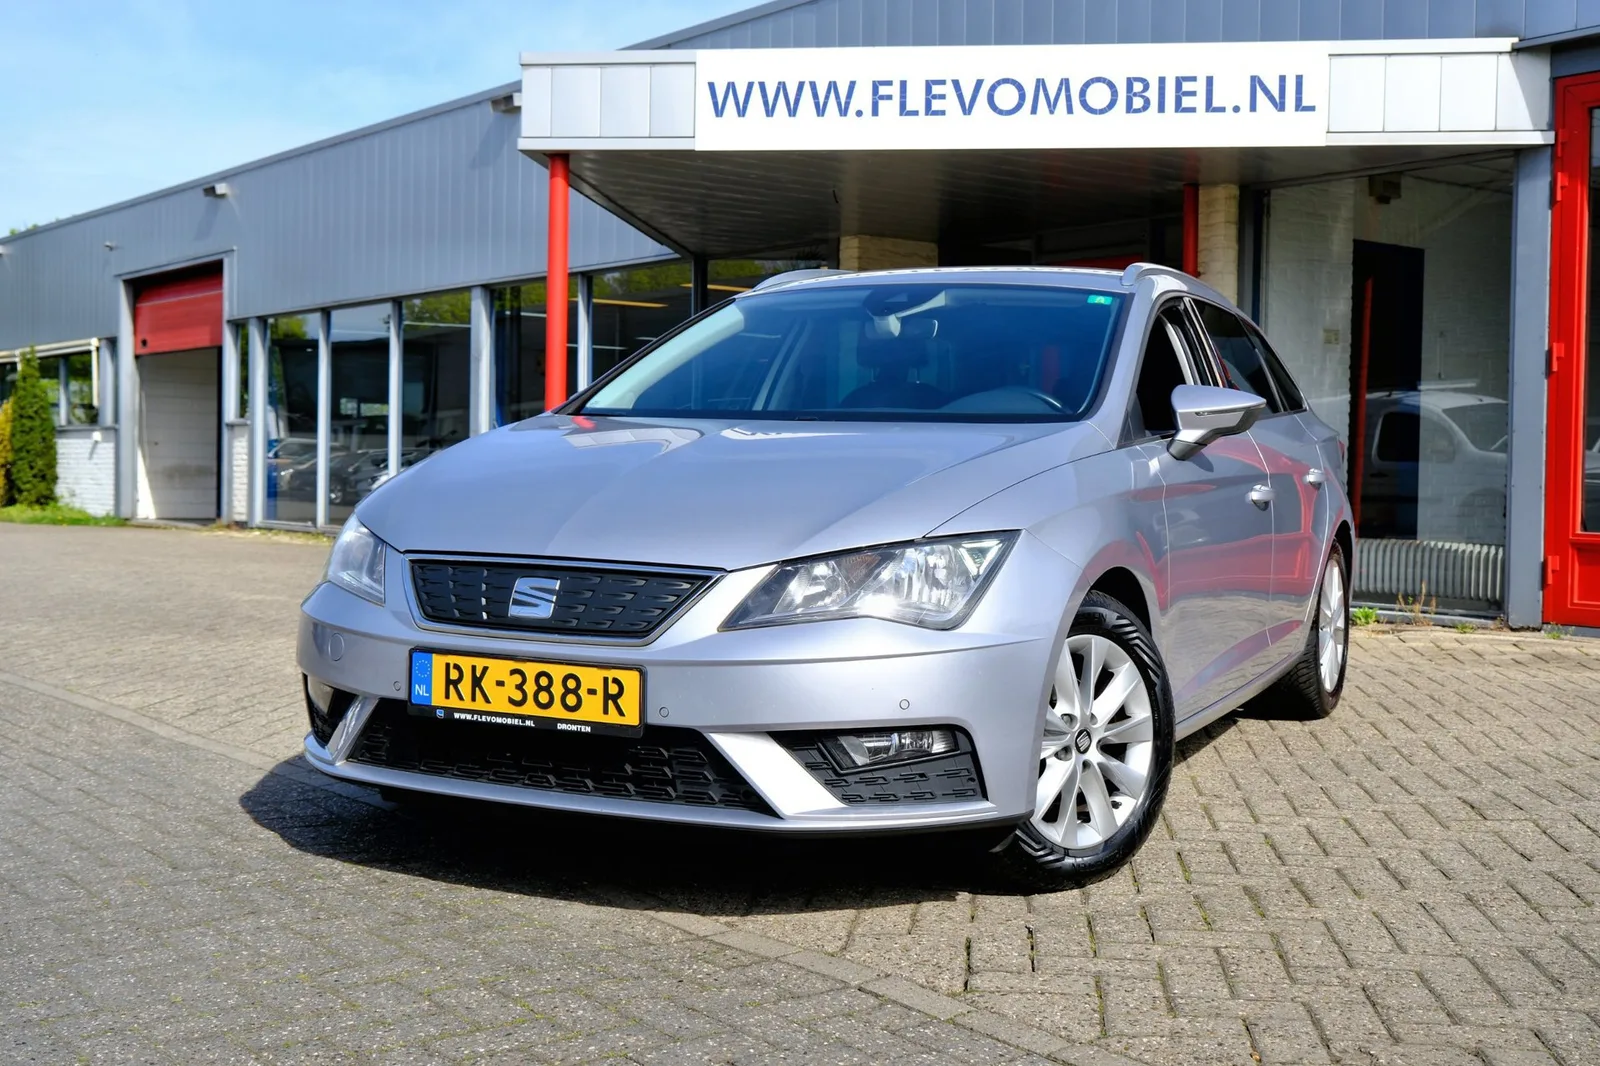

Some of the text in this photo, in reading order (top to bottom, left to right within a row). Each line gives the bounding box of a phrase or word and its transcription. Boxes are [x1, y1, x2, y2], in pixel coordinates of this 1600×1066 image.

[707, 74, 1316, 118] WWW.FLEVOMOBIEL.NL
[415, 684, 429, 696] NL
[444, 662, 626, 717] RK-388-R
[453, 712, 591, 733] WWW.FLEVOMOBIEL.NL DRONTEN
